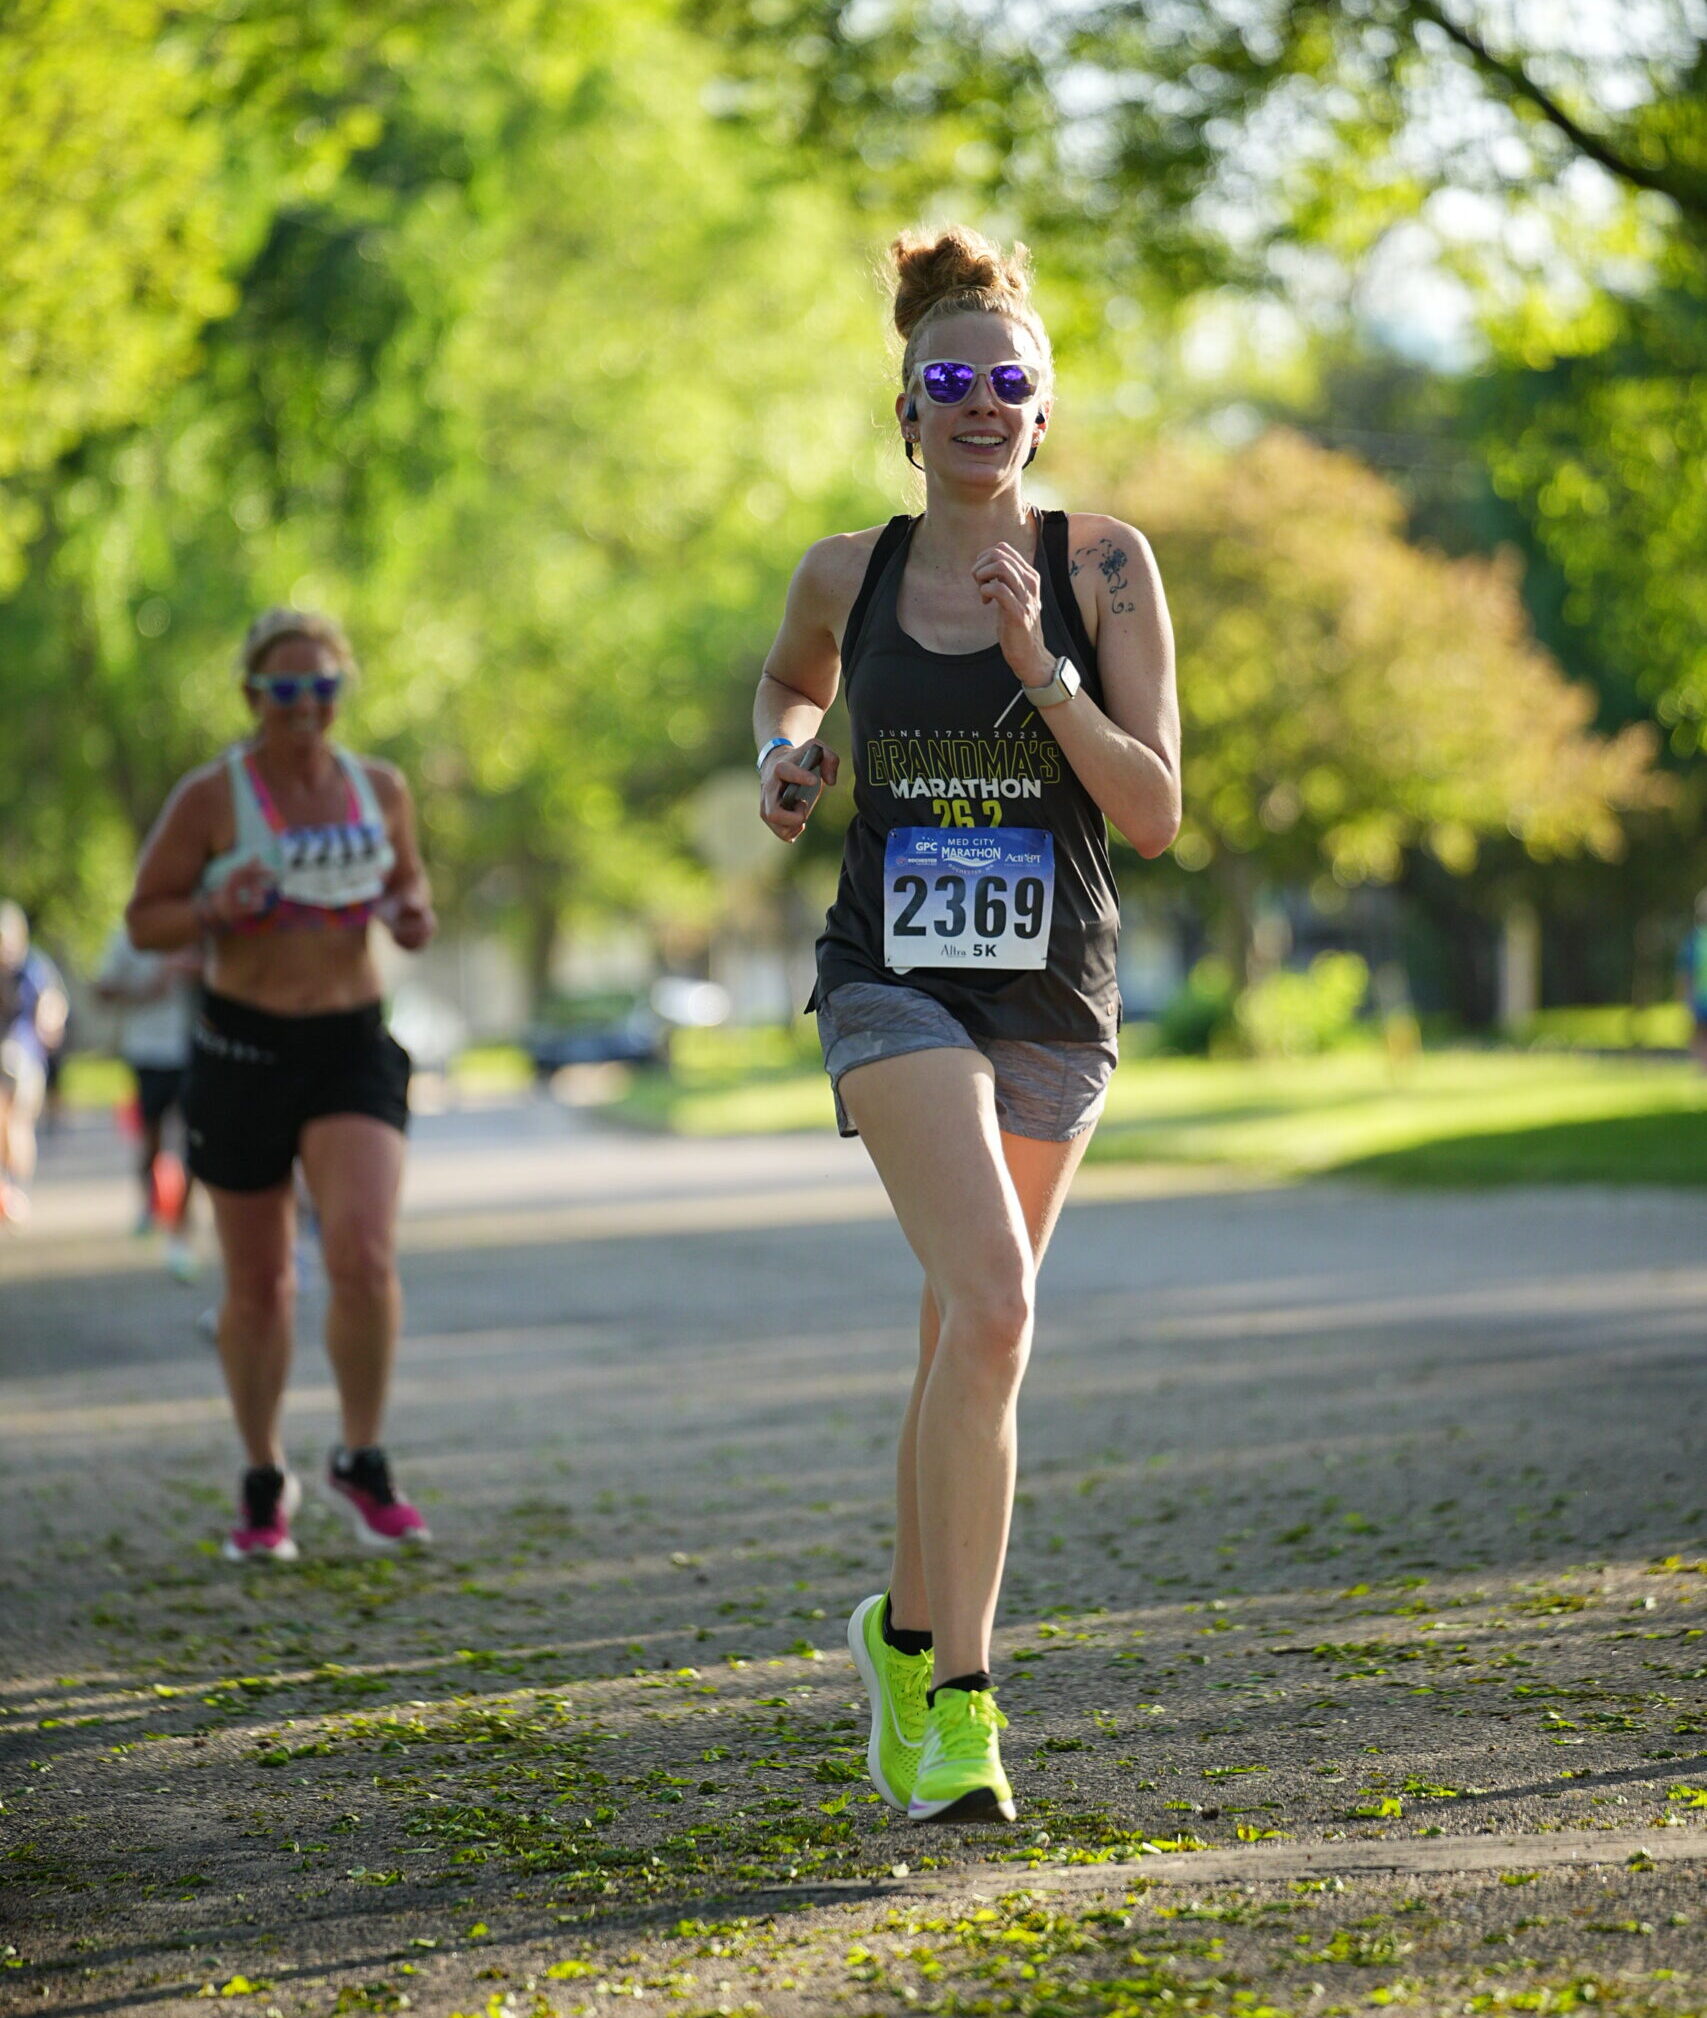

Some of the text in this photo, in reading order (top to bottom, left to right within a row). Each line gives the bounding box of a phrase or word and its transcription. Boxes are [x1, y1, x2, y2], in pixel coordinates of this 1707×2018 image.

[879, 729, 1038, 739] JUNE 17TH 2023
[867, 739, 1061, 786] GRANDMA'S
[889, 777, 1042, 799] MARATHON
[915, 842, 938, 852] GPC
[947, 838, 995, 846] MED CITY
[941, 846, 1001, 860] MARATHON
[892, 875, 1045, 940] 2369
[972, 943, 997, 957] 5K
